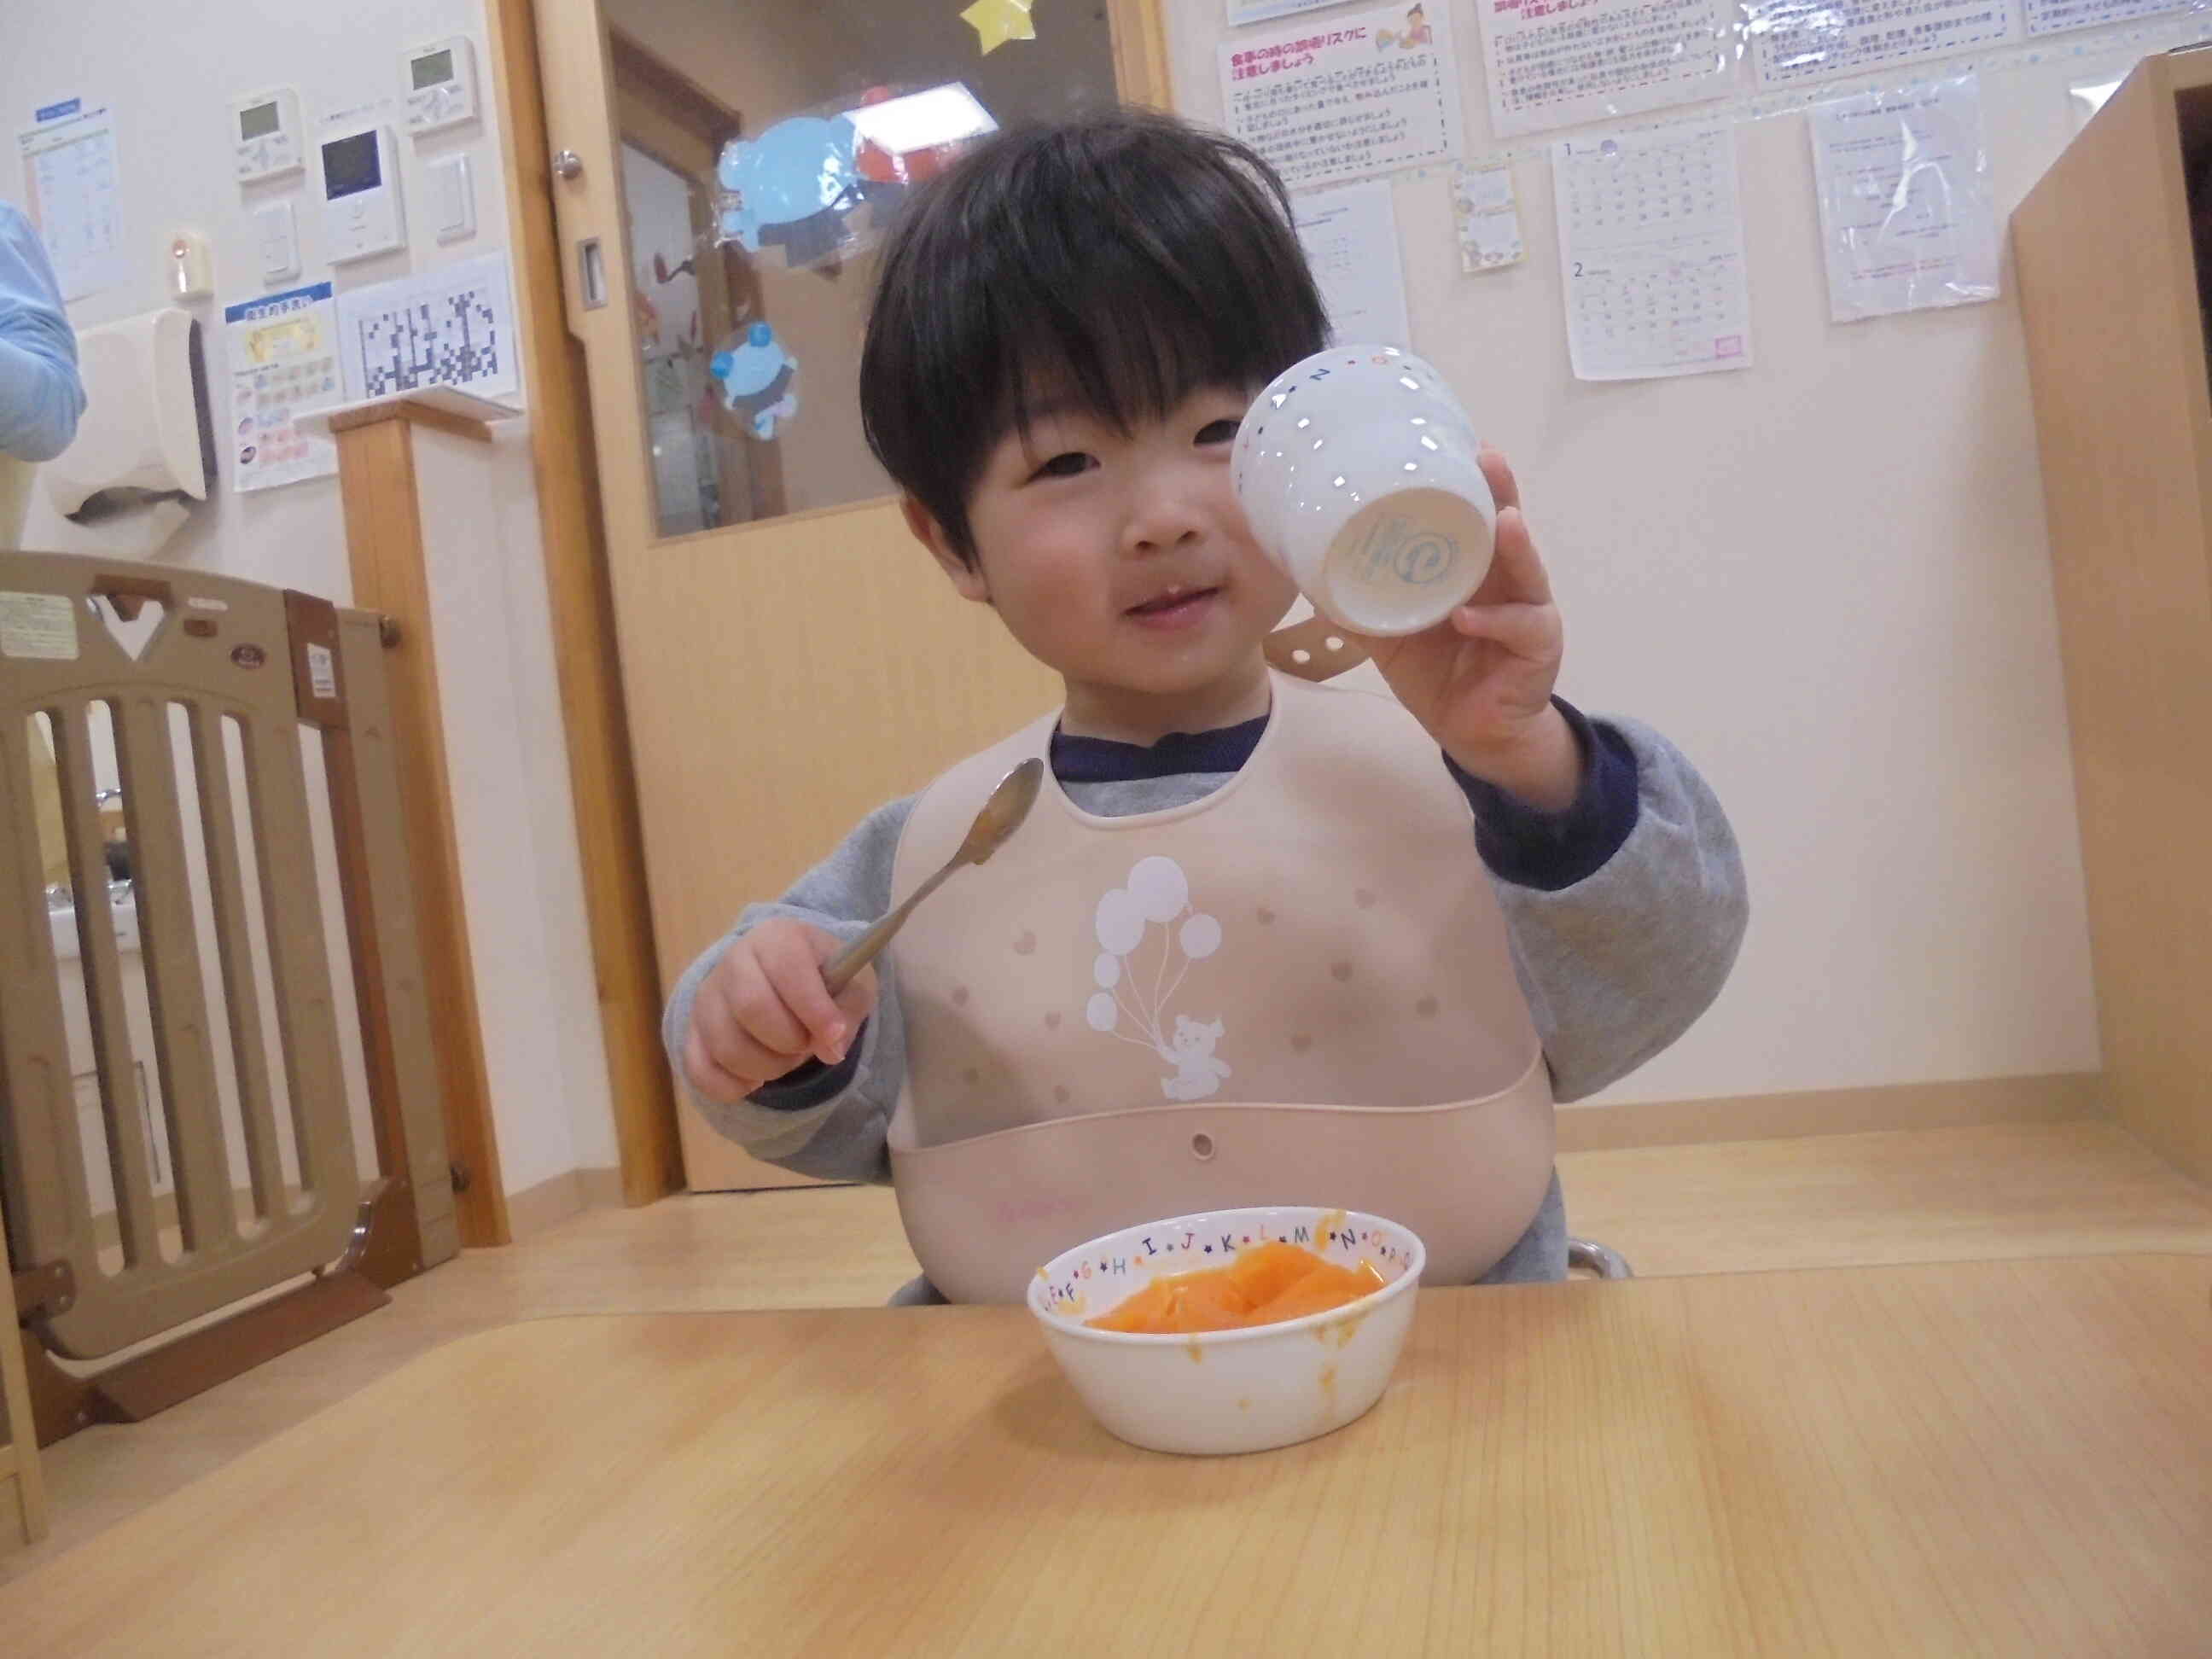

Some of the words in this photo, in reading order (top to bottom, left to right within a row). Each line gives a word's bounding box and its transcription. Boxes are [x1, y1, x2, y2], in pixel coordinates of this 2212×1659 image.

[1575, 262, 1583, 277] 2
[1113, 1258, 1126, 1275] H
[1142, 1237, 1157, 1255] I
[1181, 1232, 1195, 1250] J
[1221, 1234, 1236, 1252] K
[1294, 1226, 1309, 1243] M
[1341, 1229, 1356, 1250] N
